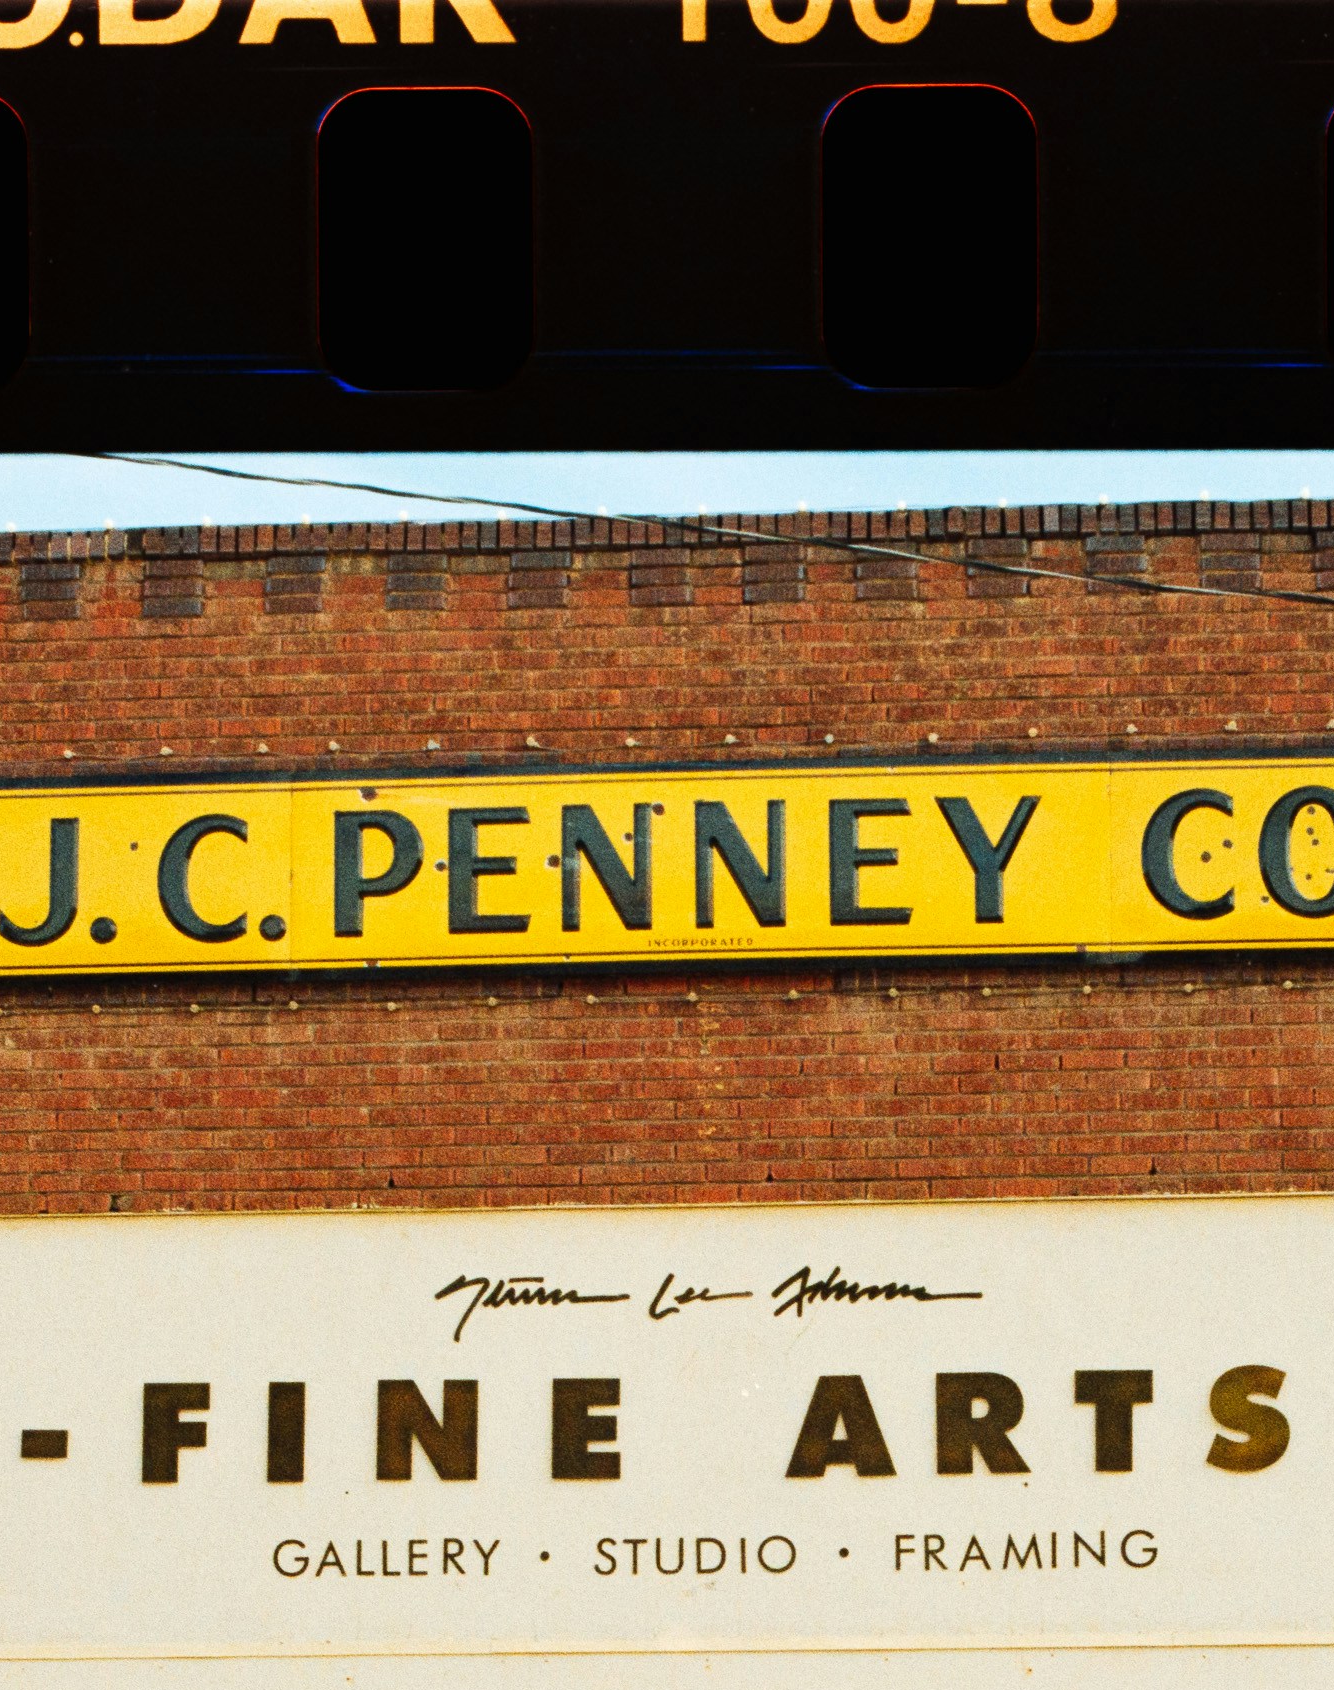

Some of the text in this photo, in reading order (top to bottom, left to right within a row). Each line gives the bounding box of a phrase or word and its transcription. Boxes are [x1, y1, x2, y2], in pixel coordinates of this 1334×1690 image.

[333, 796, 1041, 938] PENNEY
[647, 937, 754, 948] INCORPORATED
[648, 1273, 753, 1320] Lee
[141, 1364, 1291, 1485] FINE ARTS
[272, 1529, 1159, 1578] GALLERY STUDIO FRAMING
